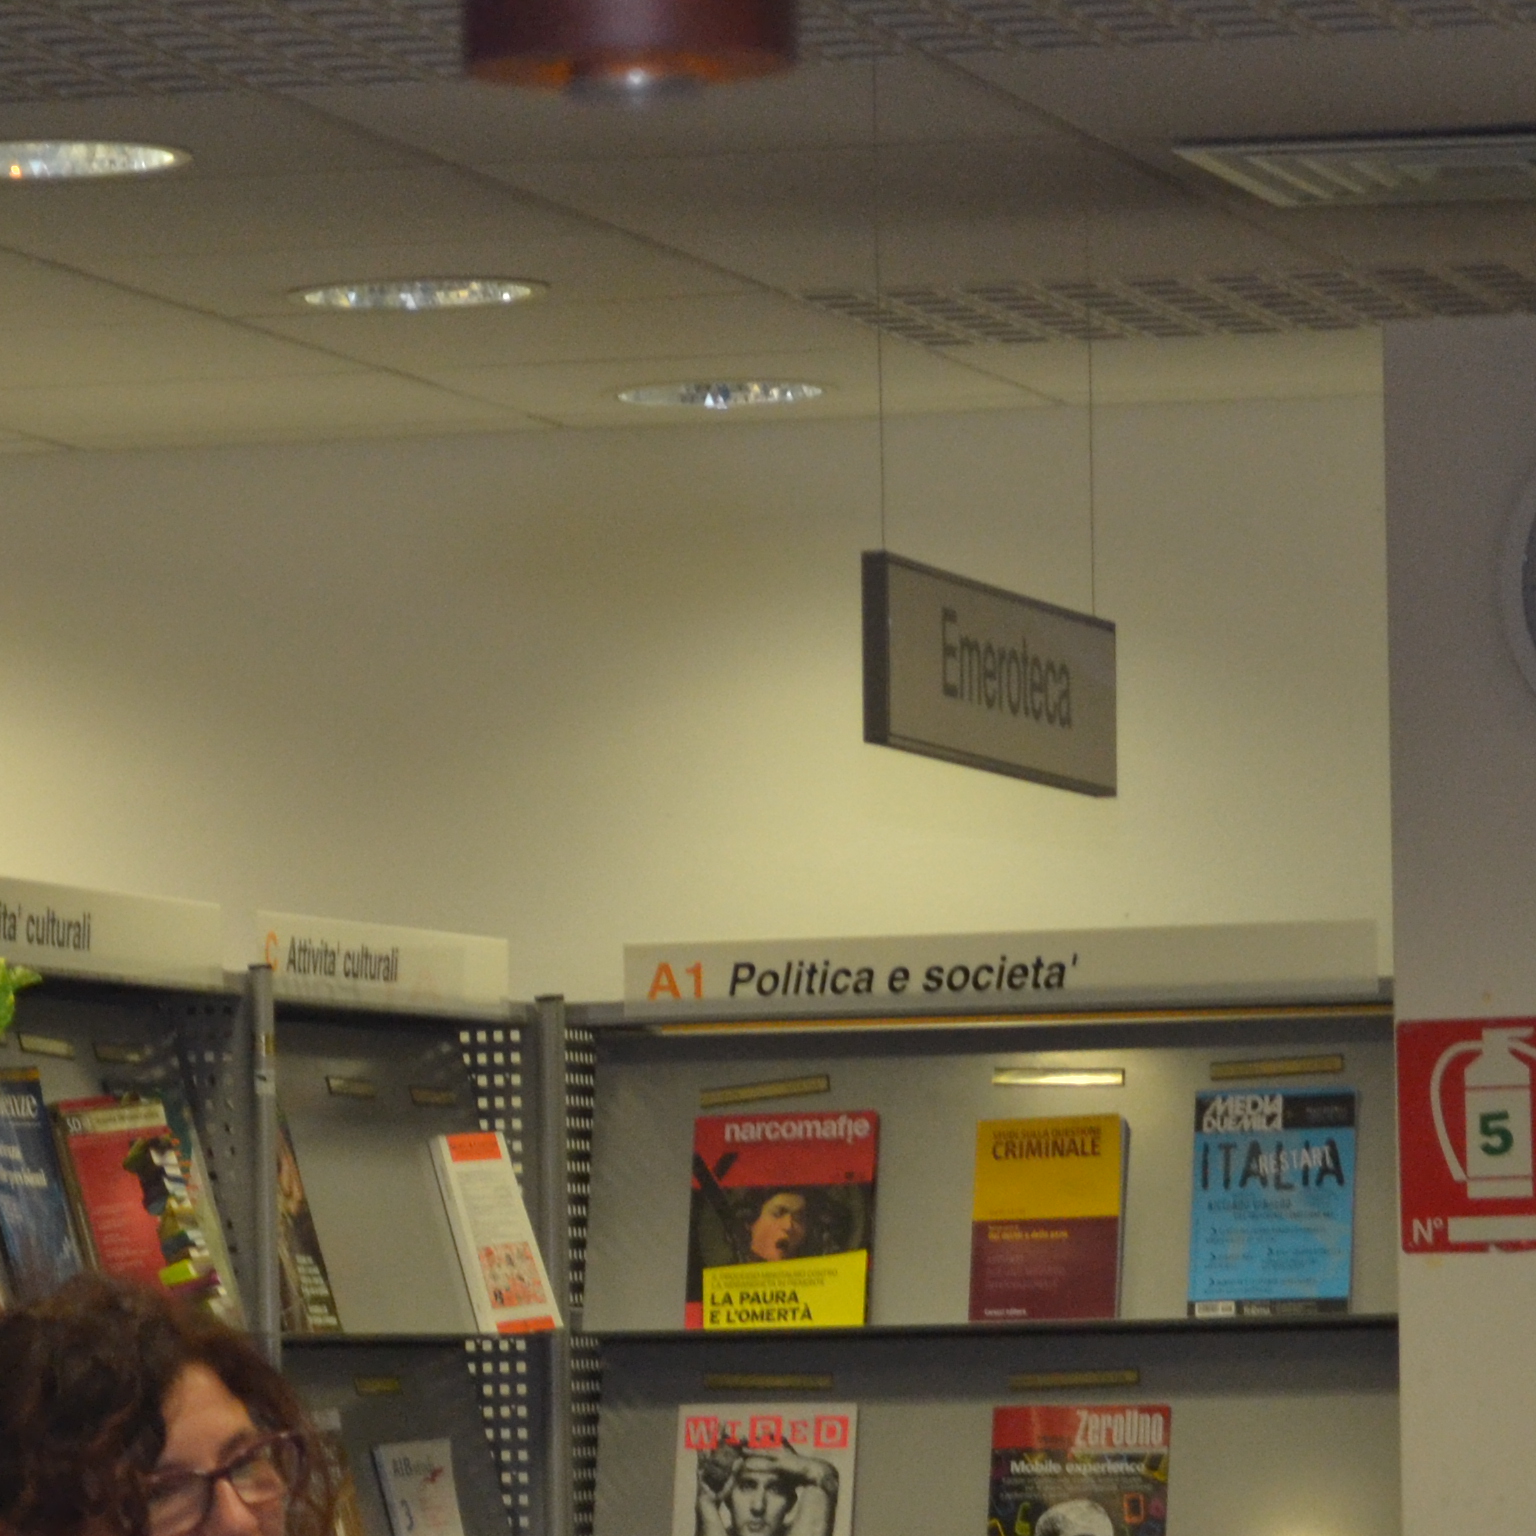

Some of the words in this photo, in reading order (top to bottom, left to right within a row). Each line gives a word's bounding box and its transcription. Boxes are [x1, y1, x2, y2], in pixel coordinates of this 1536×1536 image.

[940, 606, 1073, 729] Emeroteca
[25, 909, 92, 952] culturali
[266, 931, 278, 971] C
[285, 934, 342, 977] Attivita'
[343, 938, 400, 983] culturali
[648, 961, 705, 1001] A1
[728, 957, 876, 998] Politica
[886, 961, 912, 994] e
[921, 953, 1080, 994] societa'
[992, 1138, 1102, 1161] CRIMINALE
[1478, 1110, 1514, 1156] 5
[1201, 1138, 1345, 1190] ITALIA
[710, 1310, 720, 1324] E
[726, 1304, 813, 1324] L'OMERTÀ
[711, 1292, 733, 1306] LA
[738, 1289, 799, 1304] PAURA
[685, 1416, 849, 1449] WIRED
[1075, 1409, 1164, 1446] ZeroUno
[1010, 1459, 1063, 1475] Mobile
[1065, 1460, 1146, 1477] experience
